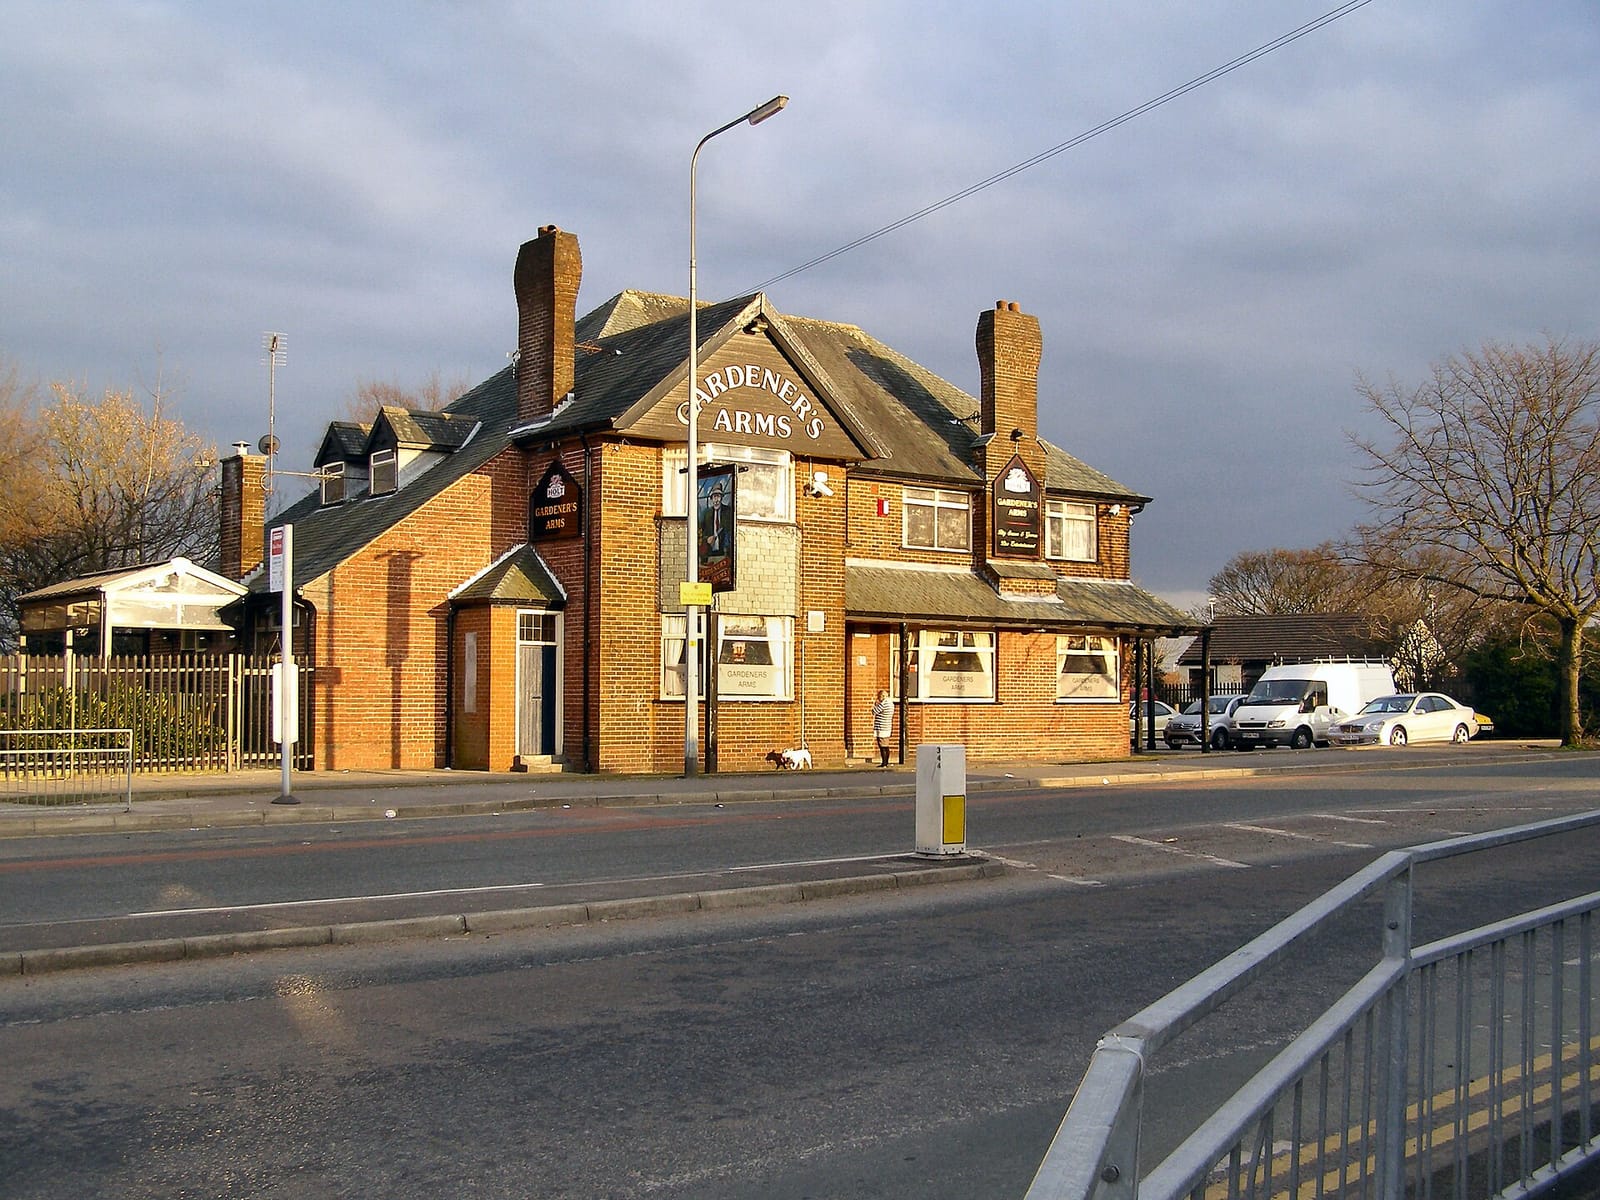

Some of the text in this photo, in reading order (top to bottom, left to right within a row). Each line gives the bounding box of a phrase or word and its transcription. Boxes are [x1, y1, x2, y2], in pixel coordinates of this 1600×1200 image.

[713, 408, 793, 439] ARMS
[535, 502, 577, 516] GARDENER'S
[545, 518, 565, 529] ARMS
[728, 670, 768, 679] GARDENERS
